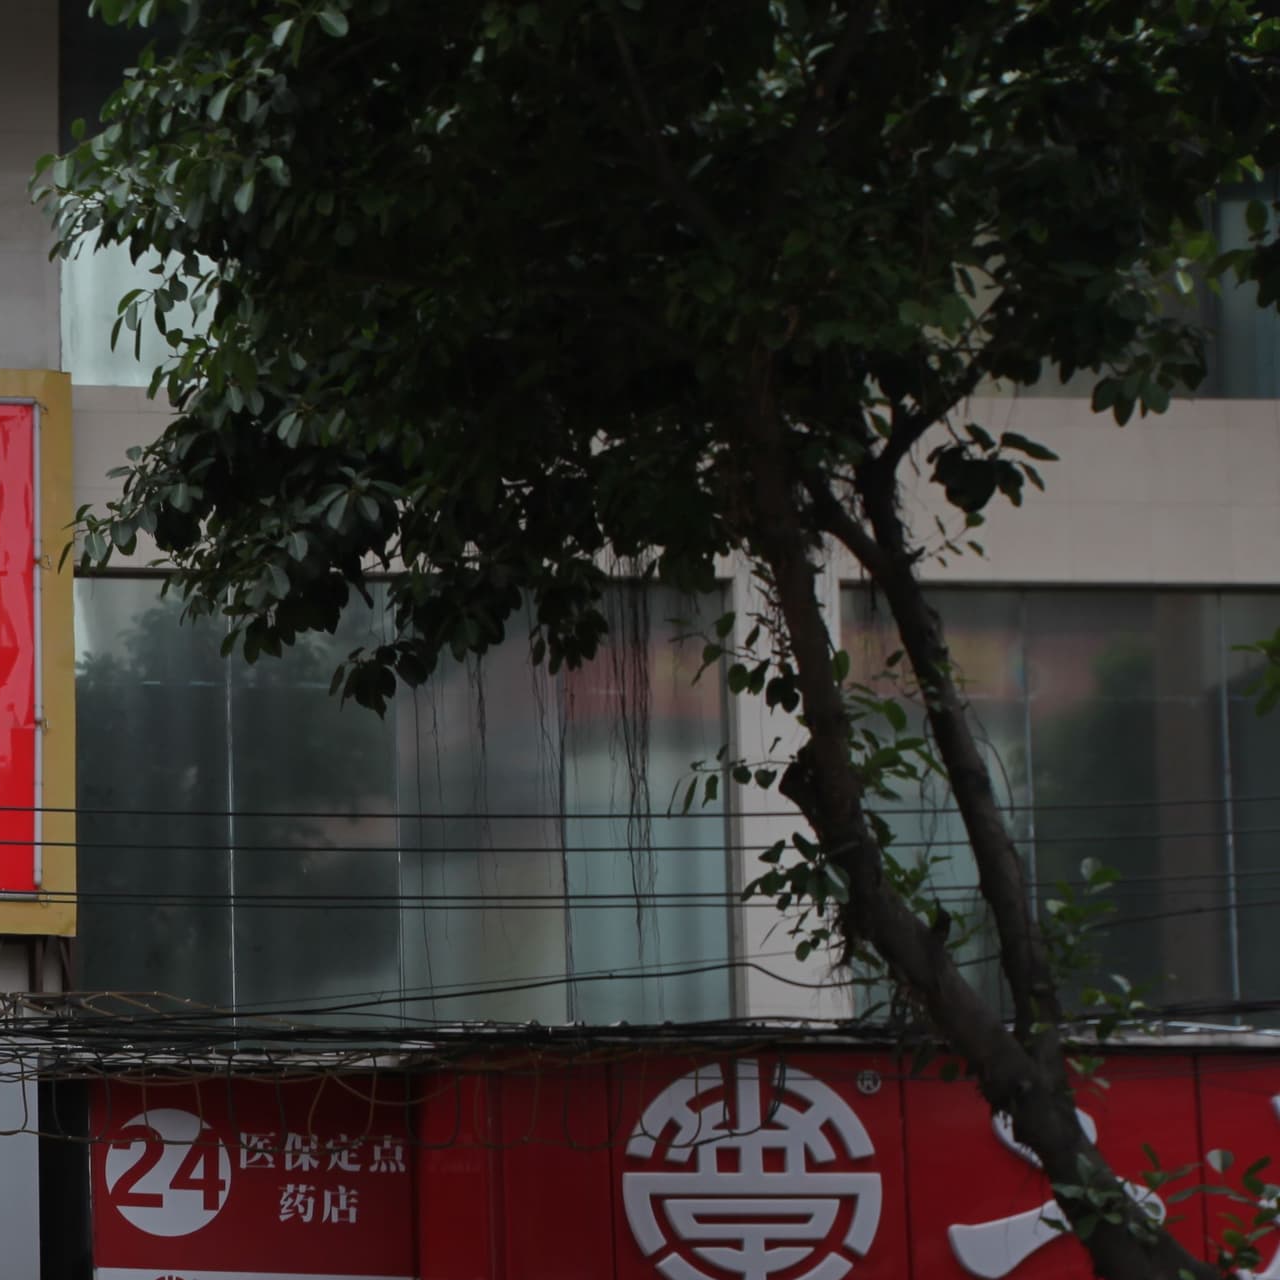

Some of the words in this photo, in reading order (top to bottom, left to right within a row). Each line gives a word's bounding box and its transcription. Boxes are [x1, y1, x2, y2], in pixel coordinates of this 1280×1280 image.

[109, 1125, 226, 1211] 24
[240, 1131, 407, 1173] 医保定点
[278, 1184, 359, 1224] 药店
